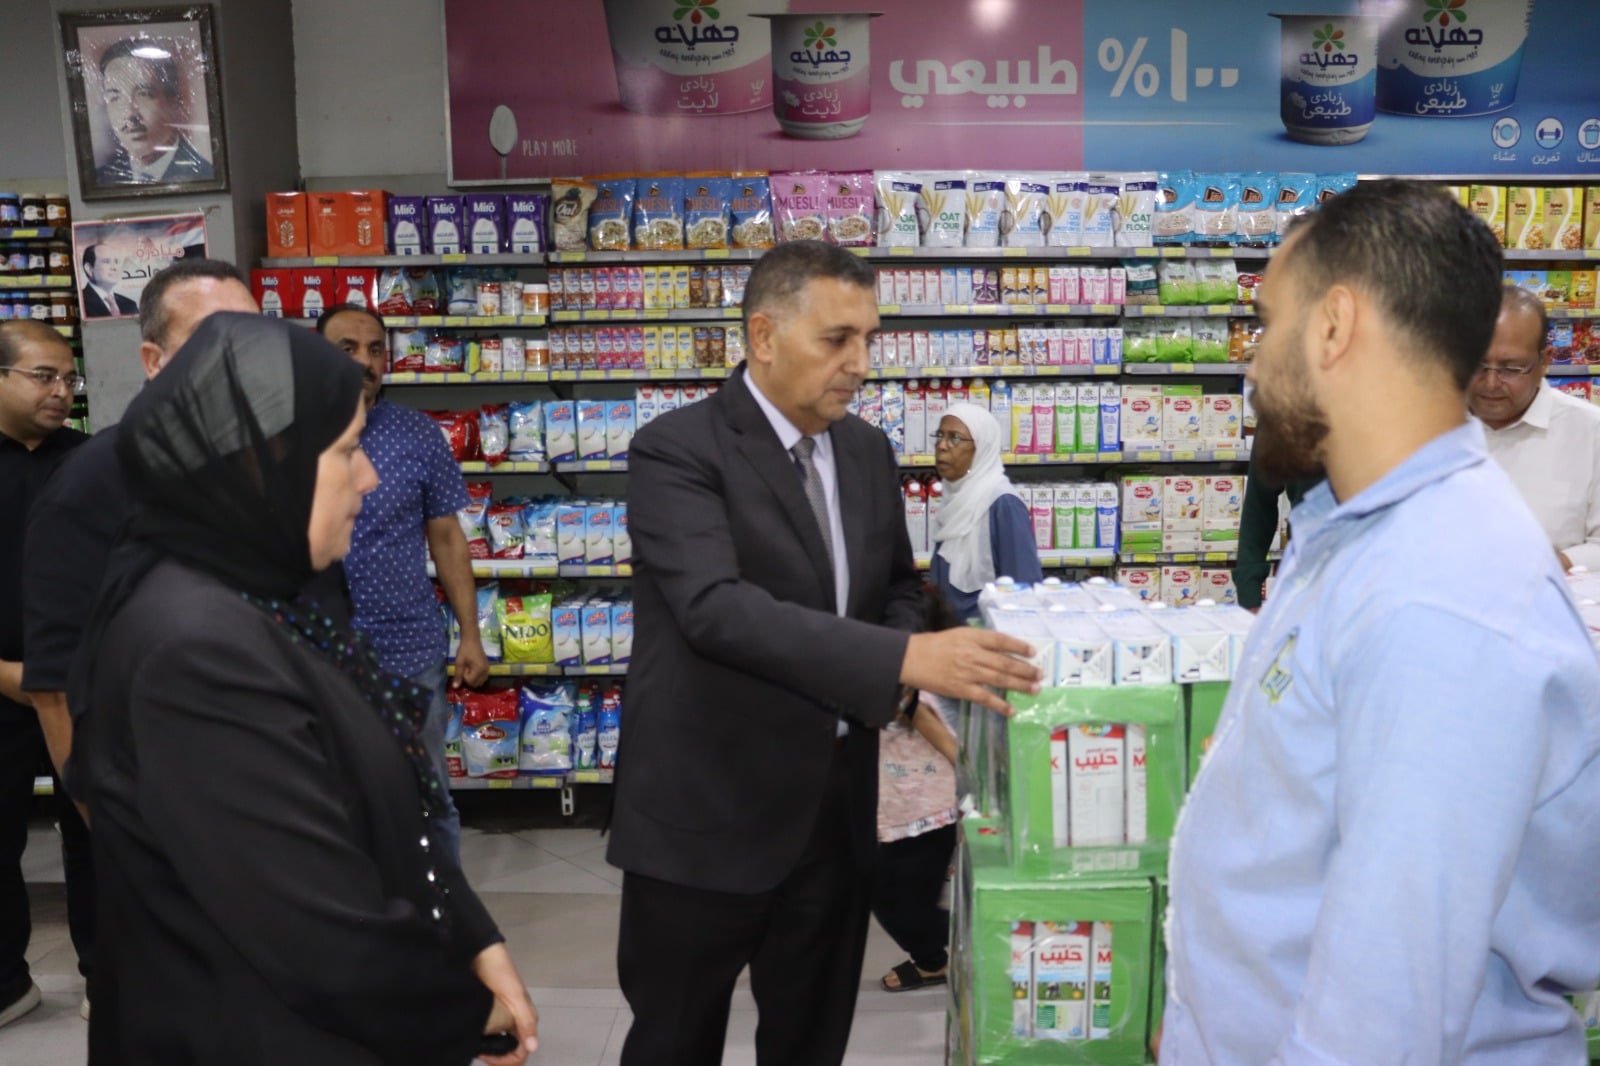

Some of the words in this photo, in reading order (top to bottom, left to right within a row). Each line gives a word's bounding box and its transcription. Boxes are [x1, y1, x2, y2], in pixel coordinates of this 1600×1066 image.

[889, 45, 1078, 109] طبيعي
[522, 140, 548, 157] PLAY
[552, 139, 578, 157] MORE
[1532, 152, 1560, 165] تمرين
[940, 212, 961, 222] OAT
[1131, 213, 1151, 223] OAT
[505, 624, 548, 639] NIDO
[1075, 754, 1118, 771] حليب
[1040, 949, 1083, 965] حليب
